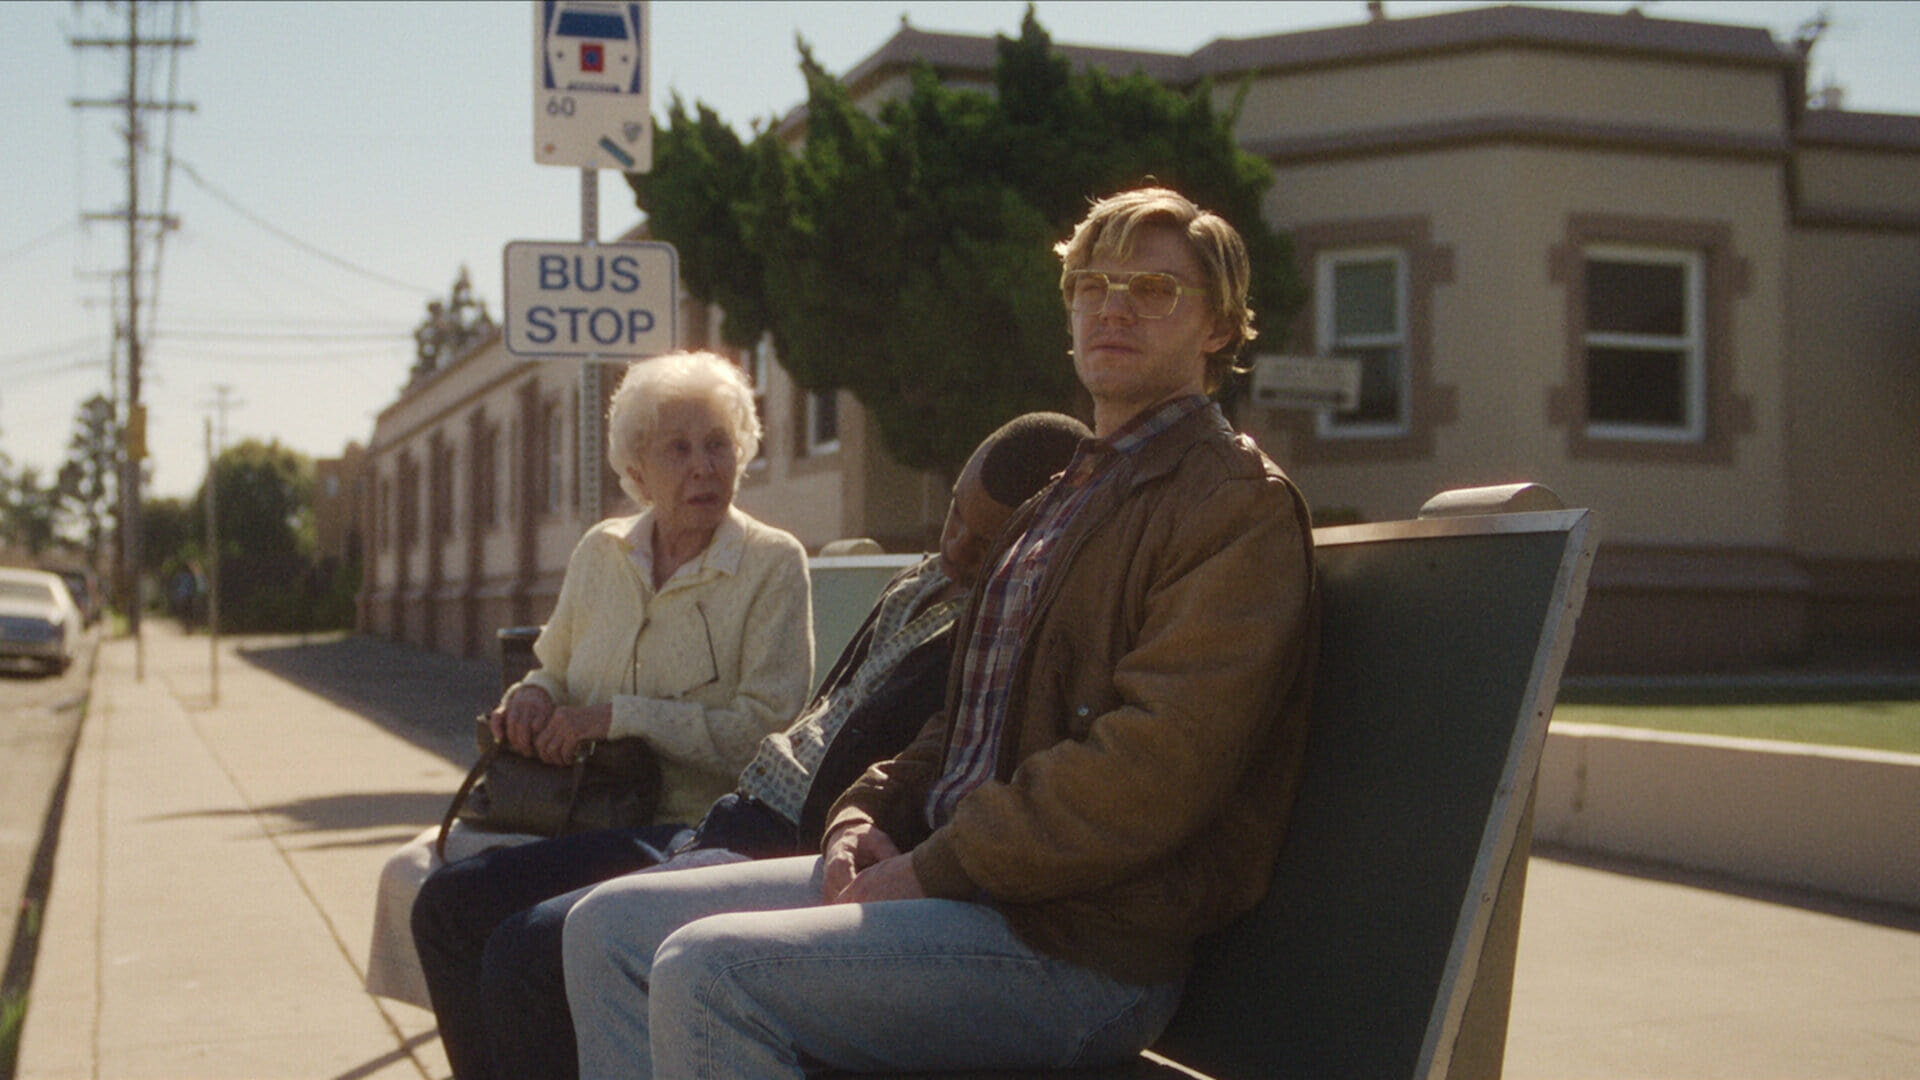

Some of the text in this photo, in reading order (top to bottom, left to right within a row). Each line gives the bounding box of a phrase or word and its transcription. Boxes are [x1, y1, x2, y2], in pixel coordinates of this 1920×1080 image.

[546, 96, 576, 116] 60
[539, 254, 640, 293] BUS
[526, 306, 655, 345] STOP
